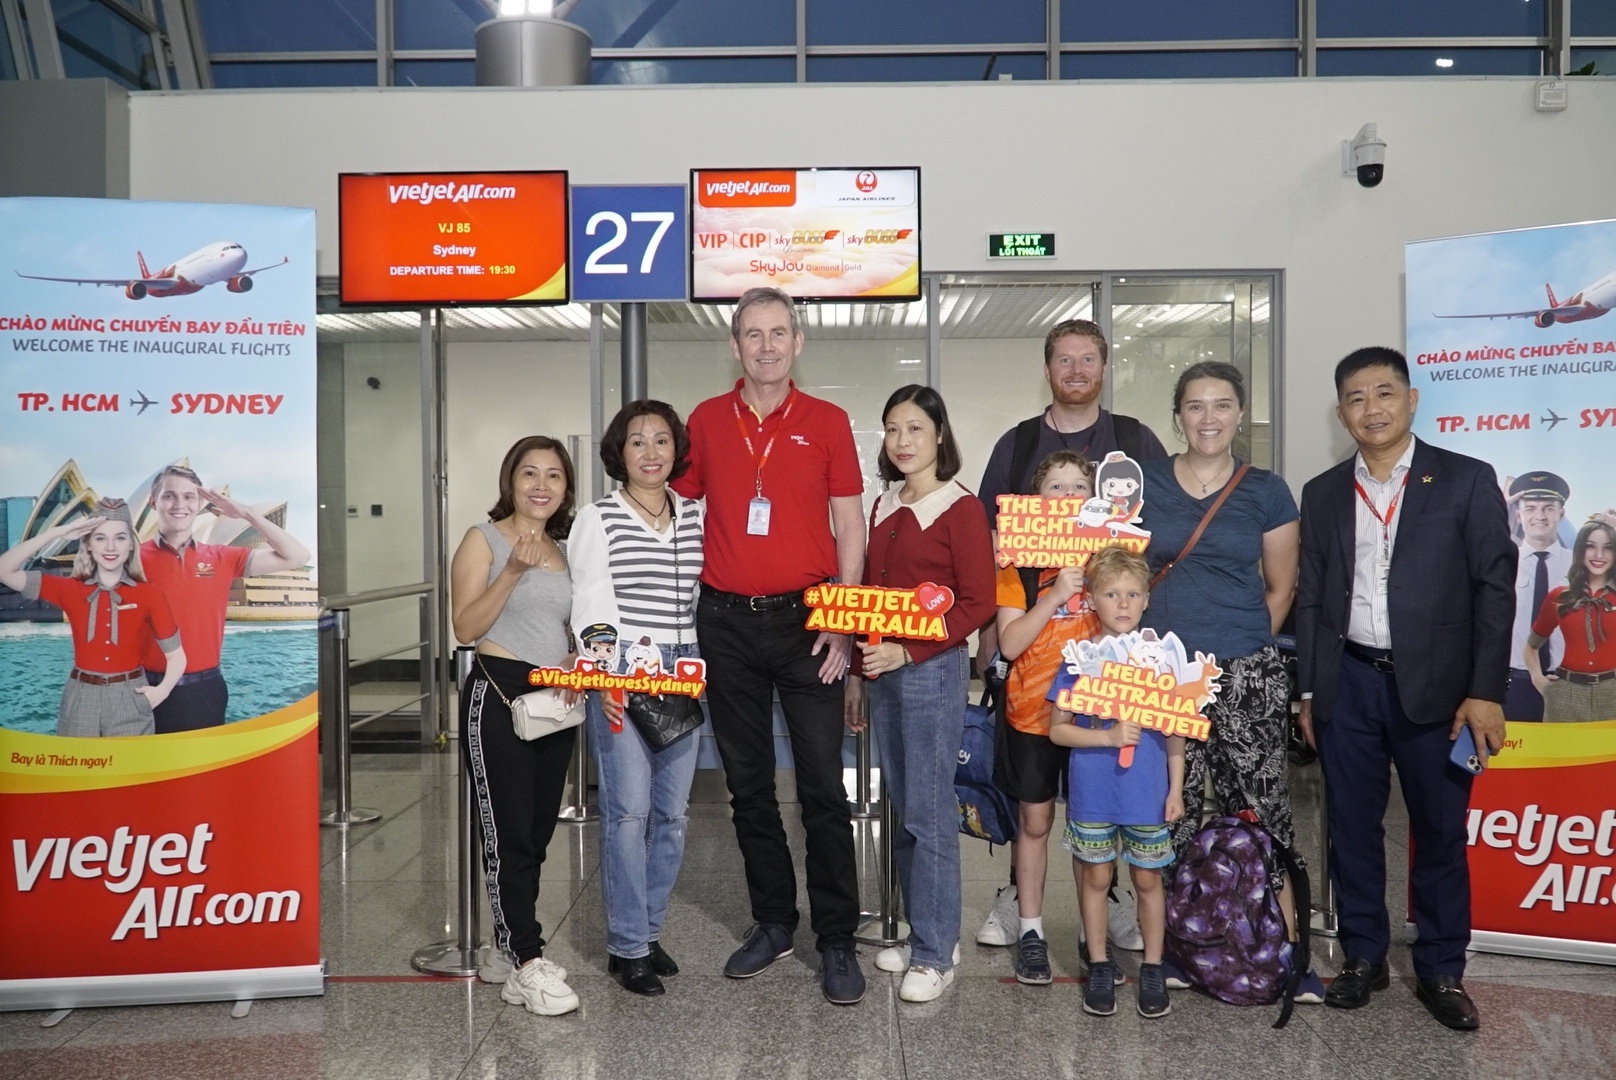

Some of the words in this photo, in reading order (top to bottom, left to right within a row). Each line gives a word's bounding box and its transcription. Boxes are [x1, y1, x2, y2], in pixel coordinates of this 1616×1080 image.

[438, 223, 454, 234] VJ
[456, 223, 471, 234] 85
[584, 211, 675, 274] 27
[699, 233, 728, 249] VIP
[739, 233, 767, 249] CIP
[1003, 235, 1041, 246] EXIT
[433, 245, 476, 257] Sydney
[390, 266, 454, 275] DEPARTURE
[456, 266, 485, 275] TIME:
[489, 265, 516, 275] 19:30
[806, 263, 839, 272] Diamond
[844, 263, 862, 272] Gold
[0, 315, 47, 331] CHÀO
[51, 314, 105, 333] MỪNG
[110, 314, 182, 333] CHUYẾN
[186, 321, 222, 334] BAY
[225, 316, 263, 335] ĐẦU
[268, 321, 306, 336] TIÊN
[12, 339, 94, 352] WELCOME
[98, 340, 129, 353] THE
[133, 340, 227, 356] INAUGURAL
[231, 343, 291, 357] FLIGHTS
[1417, 349, 1461, 365] CHÀO
[1465, 345, 1515, 361] MỪNG
[1520, 338, 1588, 358] CHUYẾN
[1593, 341, 1616, 353] BA
[1430, 365, 1505, 382] WELCOME
[1509, 364, 1537, 377] THE
[18, 393, 54, 411] TP.
[62, 394, 119, 412] HCM
[171, 393, 284, 415] SYDNEY
[1436, 416, 1470, 433] TP.
[1477, 413, 1530, 430] HCM
[999, 497, 1042, 514] THE
[1048, 499, 1083, 516] 1ST
[999, 516, 1077, 535] FLIGHT
[1016, 551, 1089, 567] SYDNEY
[926, 594, 946, 611] LOVE
[808, 608, 945, 638] AUSTRALIA
[530, 670, 703, 696] #VietjetlovesSydney
[1103, 662, 1176, 691] HELLO
[1074, 676, 1196, 716] AUSTRALIA
[1058, 692, 1114, 718] LET'S
[1119, 703, 1211, 739] VIETJET!
[11, 753, 34, 766] Bay
[35, 753, 46, 765] là
[48, 755, 78, 767] Thích
